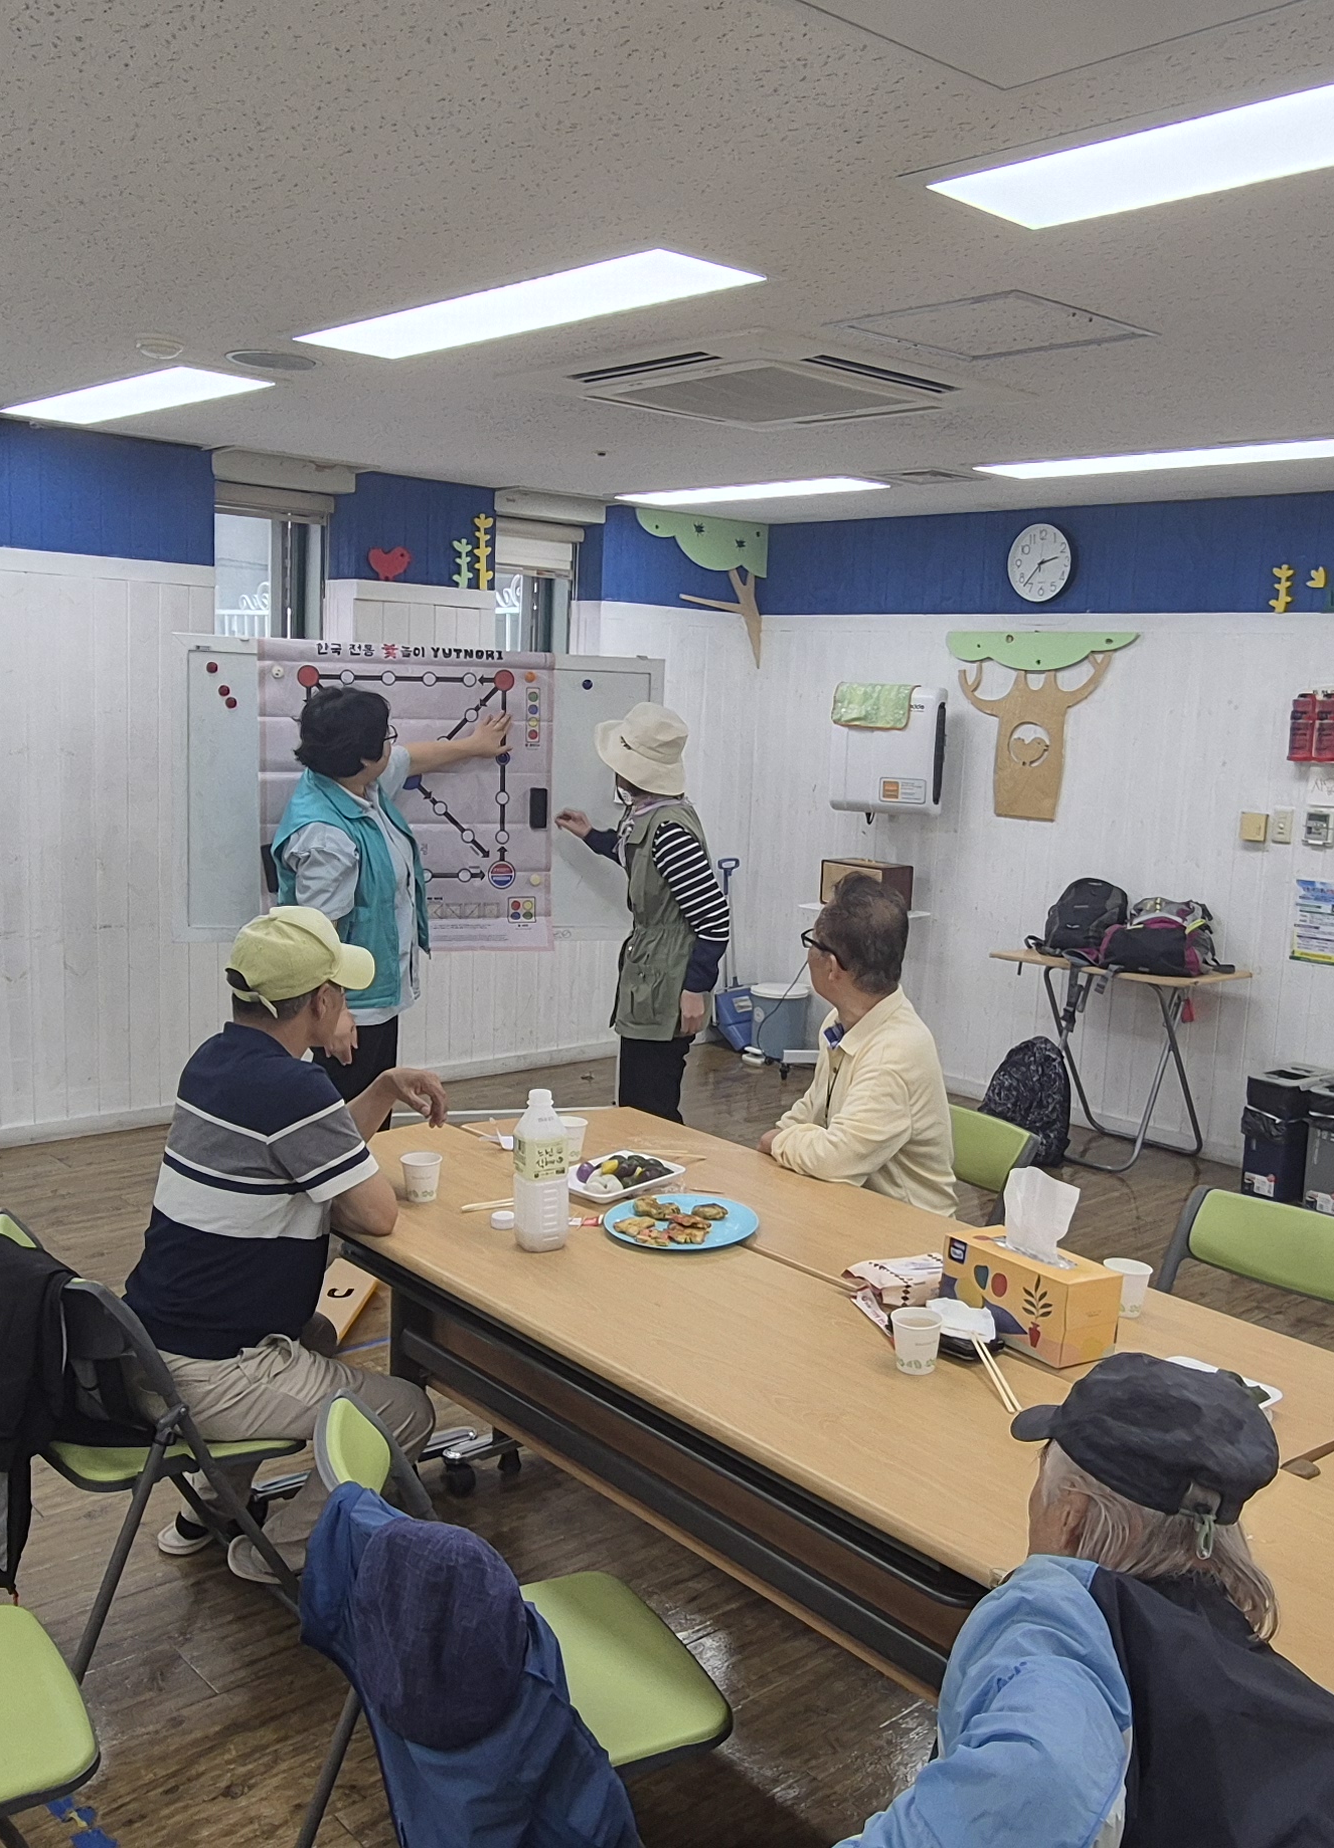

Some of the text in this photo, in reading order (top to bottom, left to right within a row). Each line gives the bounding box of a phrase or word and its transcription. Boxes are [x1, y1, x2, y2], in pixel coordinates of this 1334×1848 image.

[1060, 542, 1067, 553] 2
[1015, 559, 1022, 569] 9
[1019, 572, 1025, 584] 8
[1059, 570, 1065, 581] 4
[1027, 582, 1033, 593] 7
[1037, 587, 1044, 597] 6
[1050, 581, 1056, 592] 5
[316, 642, 342, 656] 한국
[348, 643, 375, 657] 전통
[430, 646, 504, 661] YUTNORI
